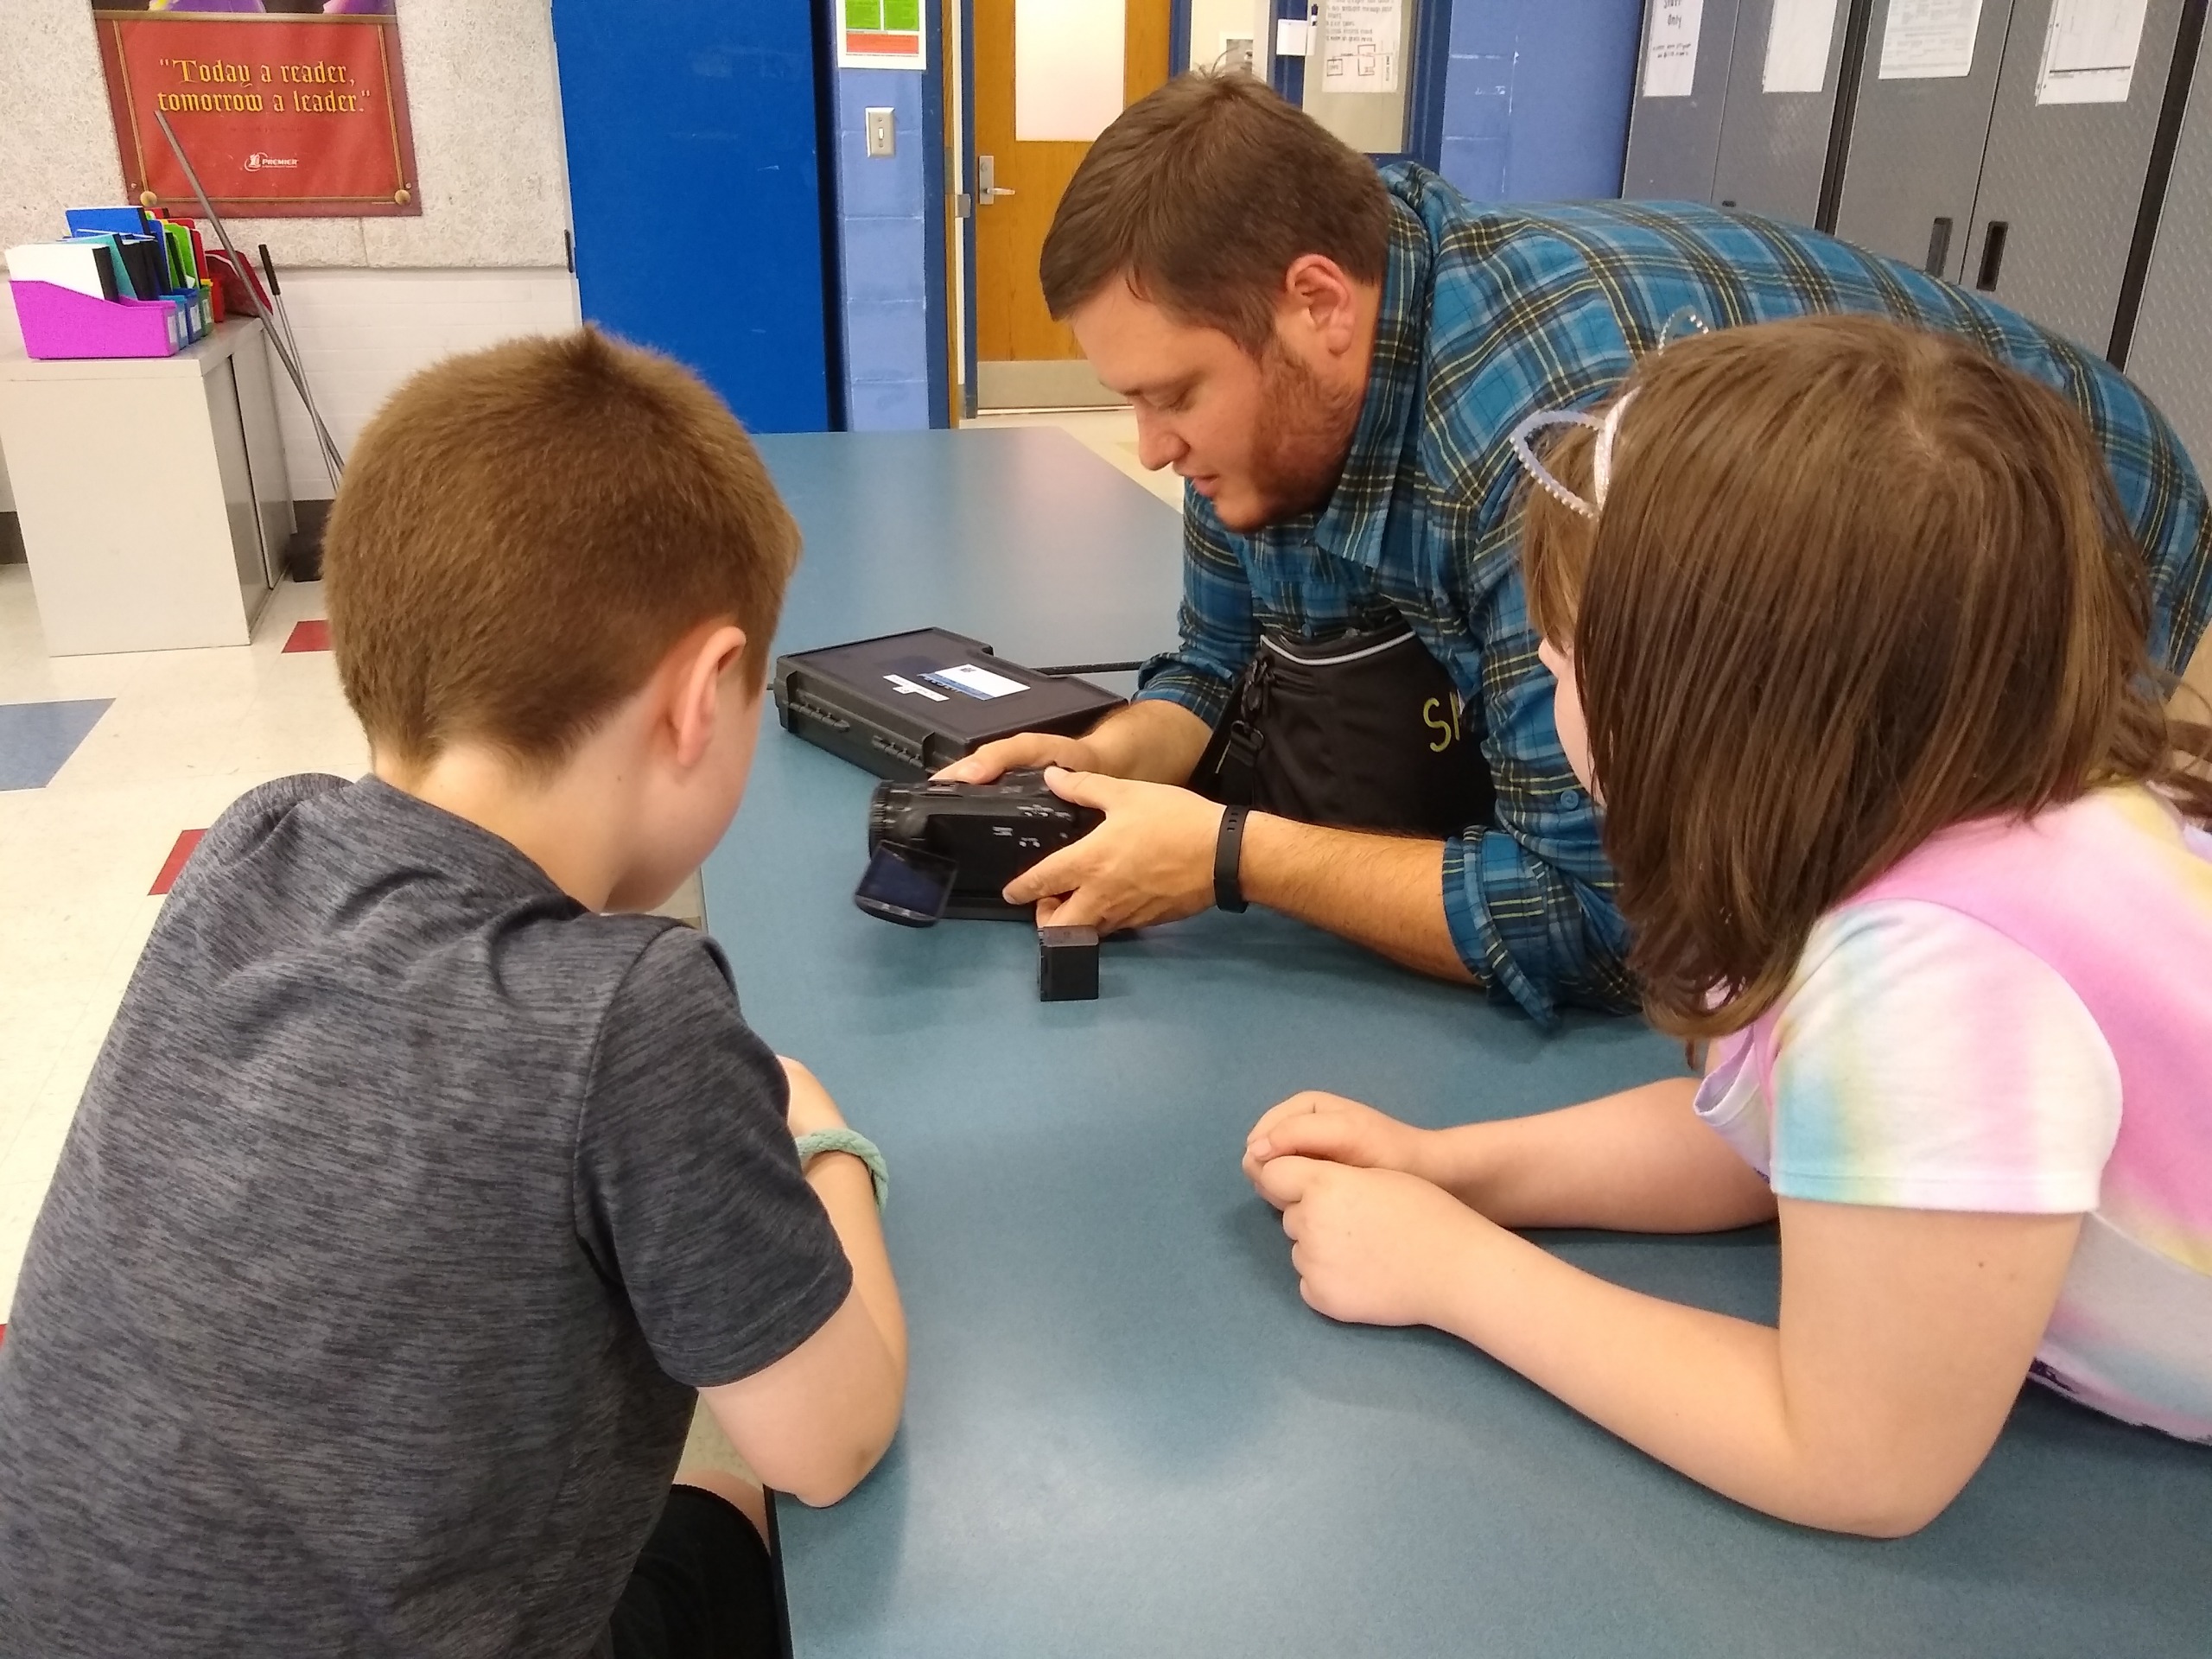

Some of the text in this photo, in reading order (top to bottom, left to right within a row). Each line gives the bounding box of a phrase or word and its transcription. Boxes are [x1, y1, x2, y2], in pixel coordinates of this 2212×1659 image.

[159, 60, 356, 87] "Today a reader,
[157, 90, 371, 112] tomorrow a leader."
